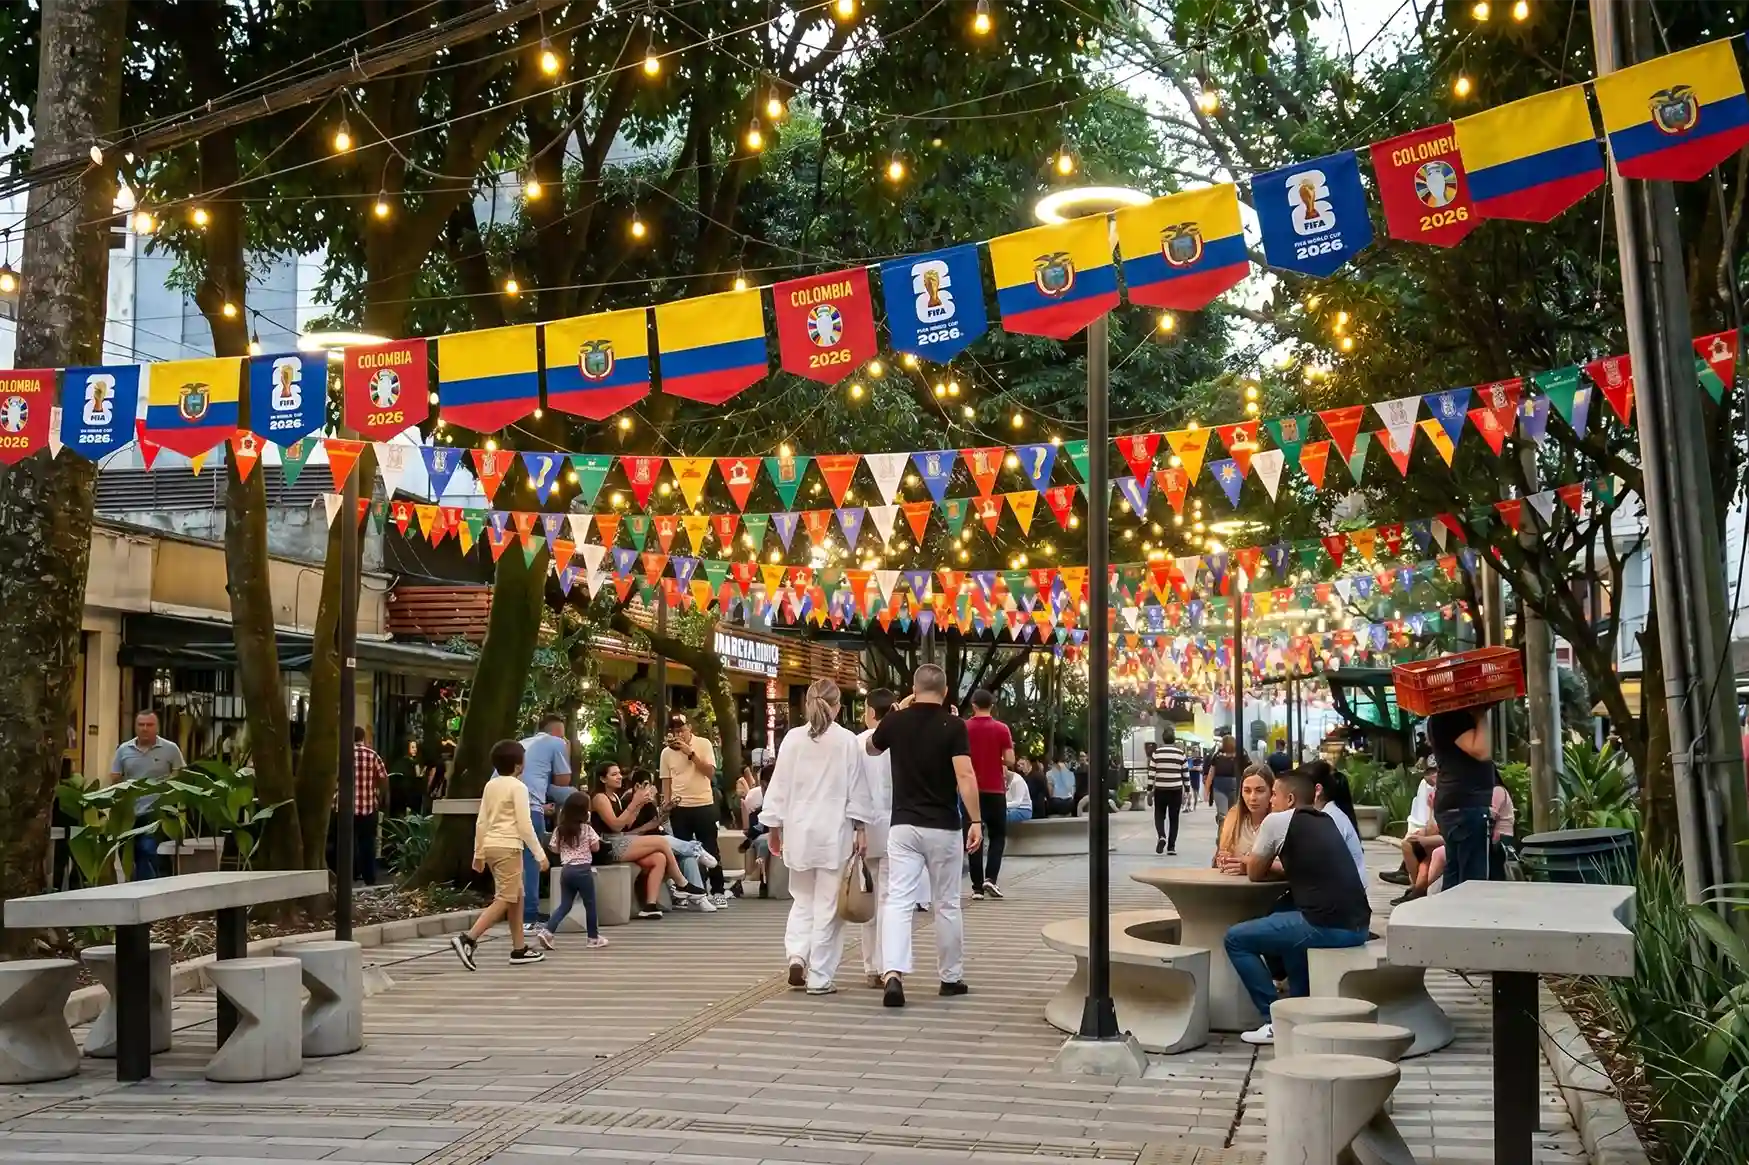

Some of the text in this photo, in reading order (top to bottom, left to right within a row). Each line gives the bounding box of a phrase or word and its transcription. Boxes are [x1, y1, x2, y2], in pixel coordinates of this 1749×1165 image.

[1304, 219, 1327, 231] FIFA
[1419, 206, 1469, 232] 2026
[1296, 239, 1343, 260] 2026
[791, 279, 853, 307] COLOMBIA
[927, 307, 946, 318] FIFA
[917, 328, 960, 346] 2026
[358, 350, 412, 369] COLOMBIA
[808, 348, 851, 369] 2026
[0, 379, 41, 393] OLOMBIA
[270, 418, 302, 430] 2026
[367, 411, 404, 426] 2026
[79, 434, 110, 443] 2026
